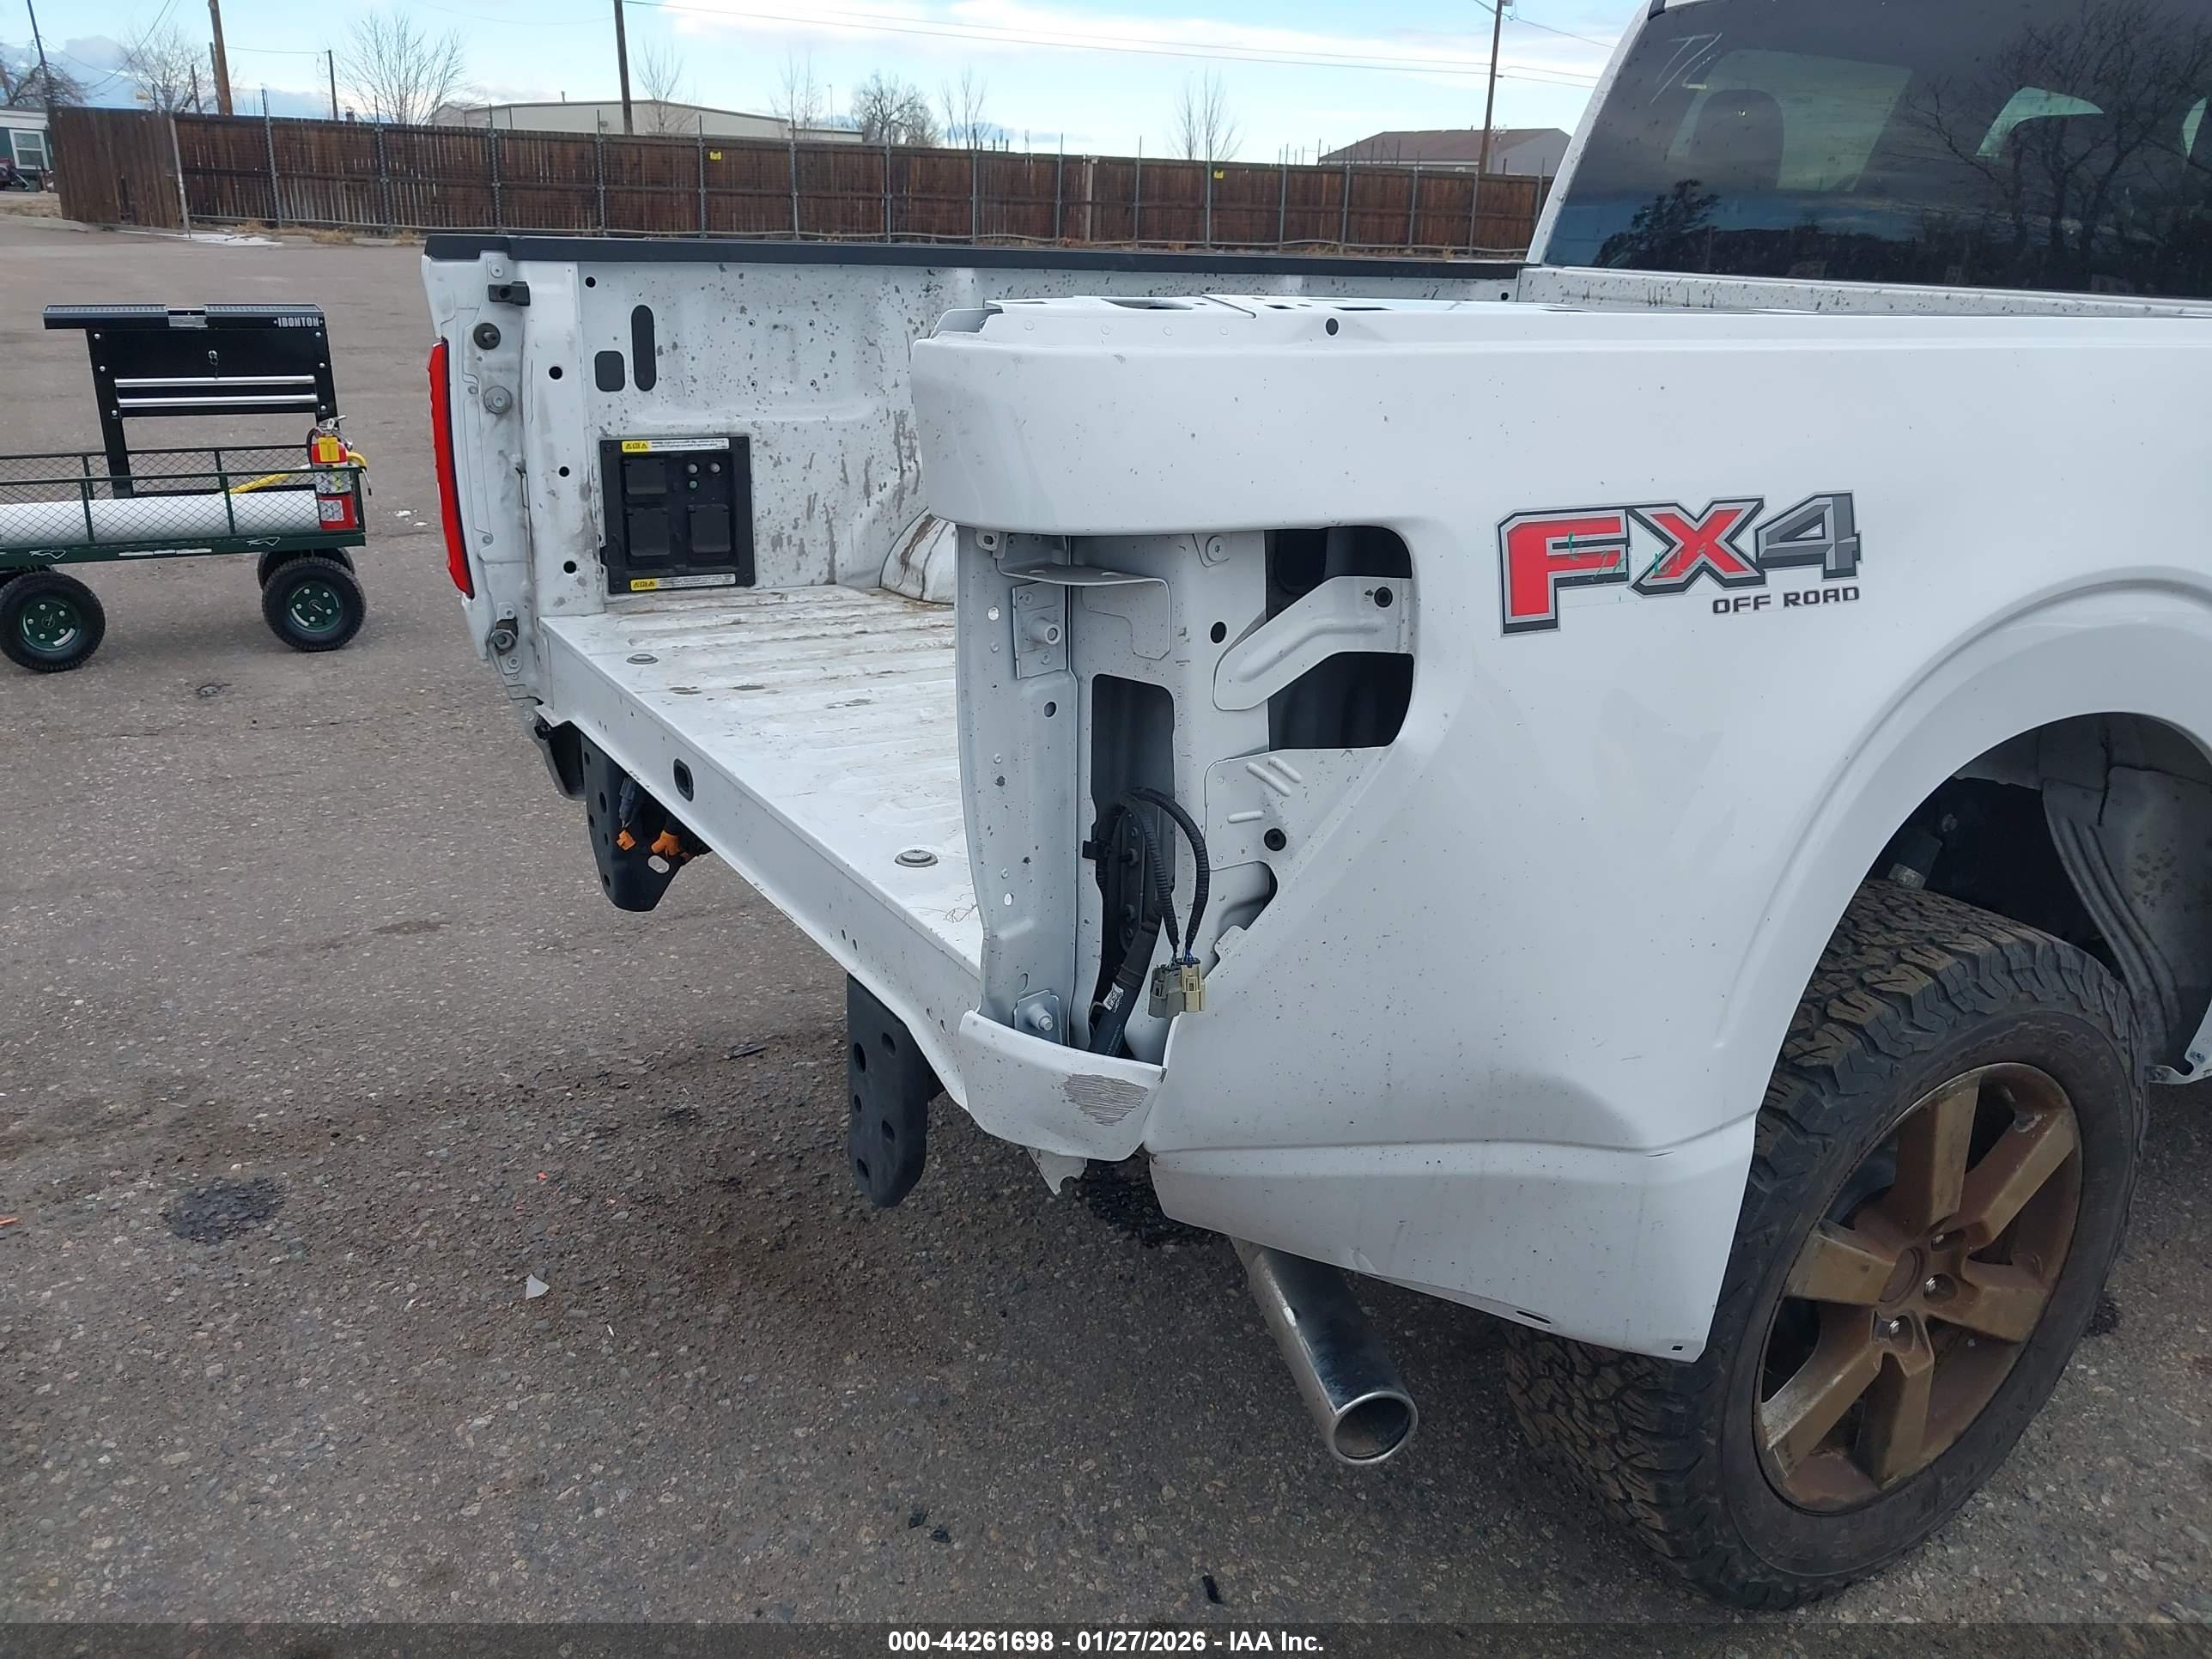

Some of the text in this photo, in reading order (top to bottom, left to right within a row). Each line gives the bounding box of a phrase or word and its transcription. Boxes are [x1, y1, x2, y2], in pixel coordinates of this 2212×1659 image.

[277, 316, 319, 328] IRONTON
[1496, 489, 1863, 637] FX4
[1712, 586, 1861, 615] OFF ROAD
